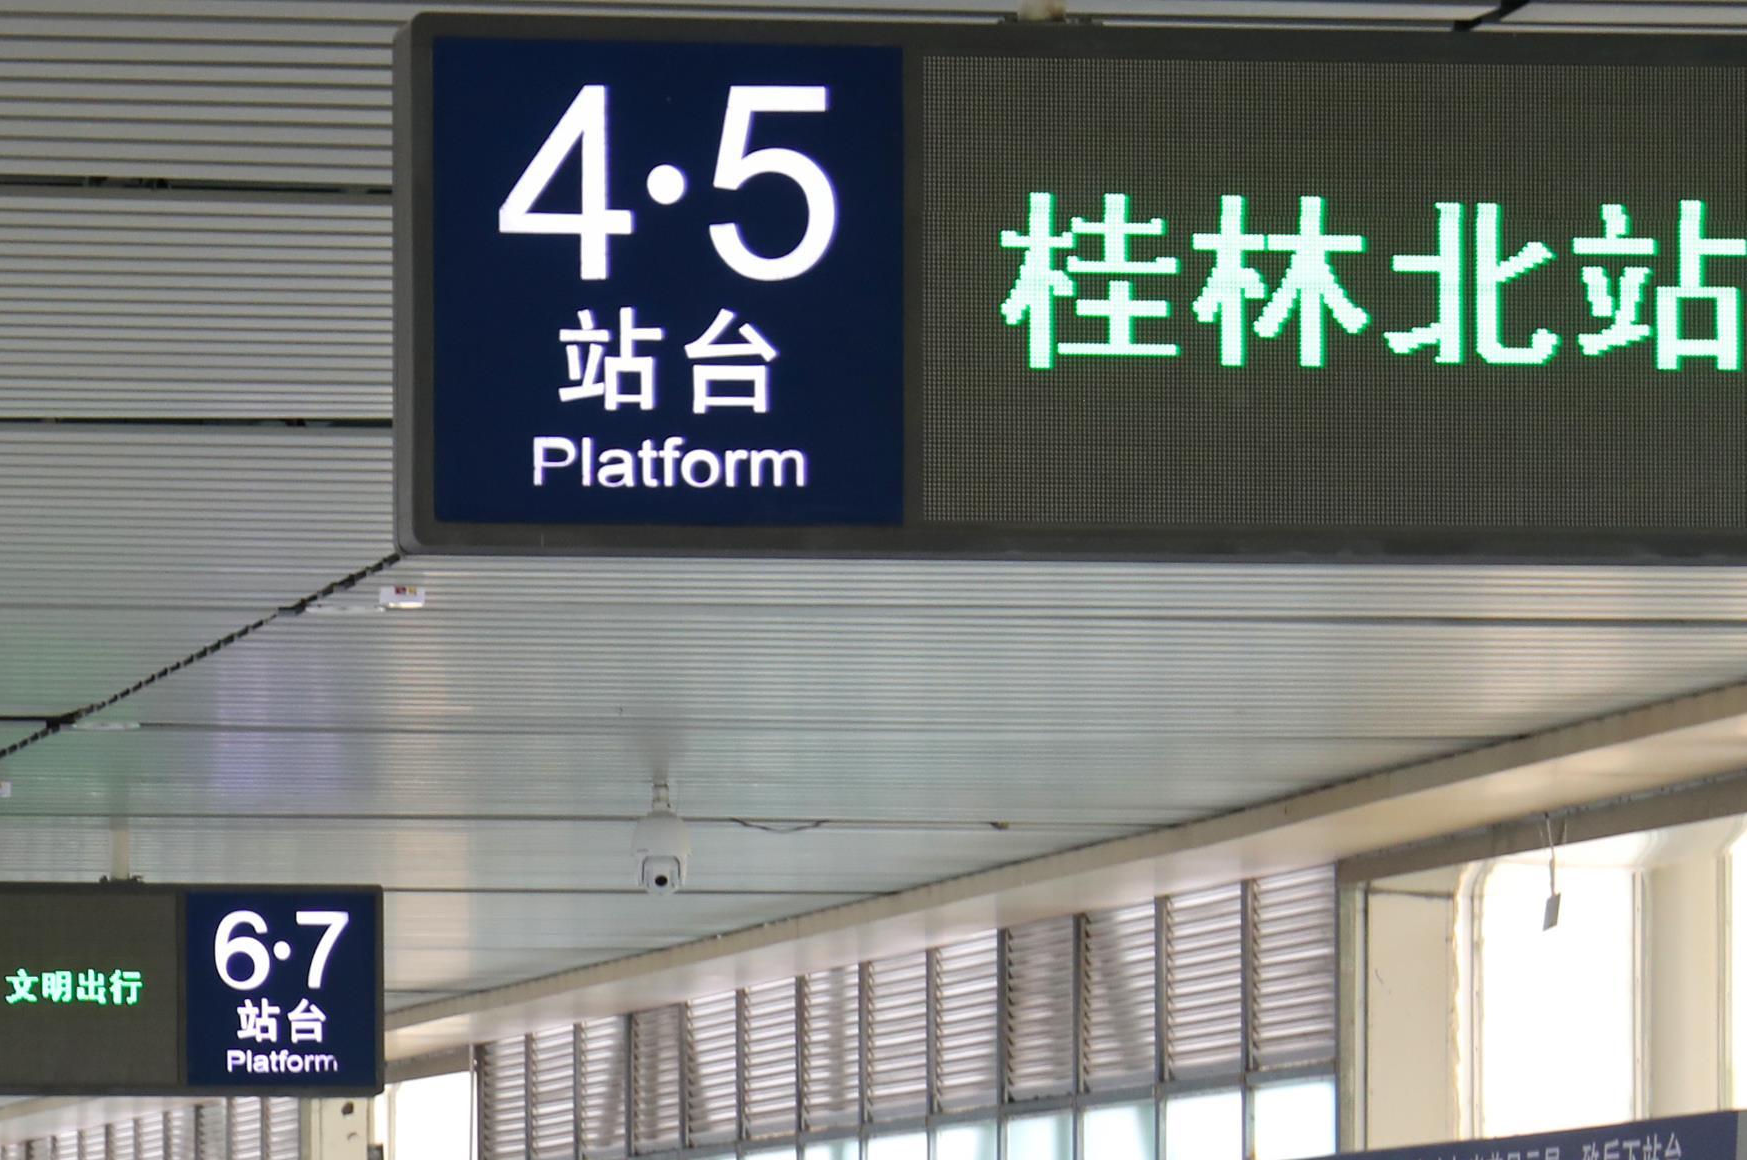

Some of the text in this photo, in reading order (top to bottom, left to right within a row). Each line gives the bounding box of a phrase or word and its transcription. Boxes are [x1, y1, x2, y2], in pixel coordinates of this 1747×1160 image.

[1000, 192, 1747, 371] 桂林北站
[559, 307, 778, 414] 站台
[533, 437, 806, 488] Platform
[6, 969, 143, 1006] 文明出行
[237, 998, 327, 1044] 站台
[226, 1050, 339, 1073] Platform
